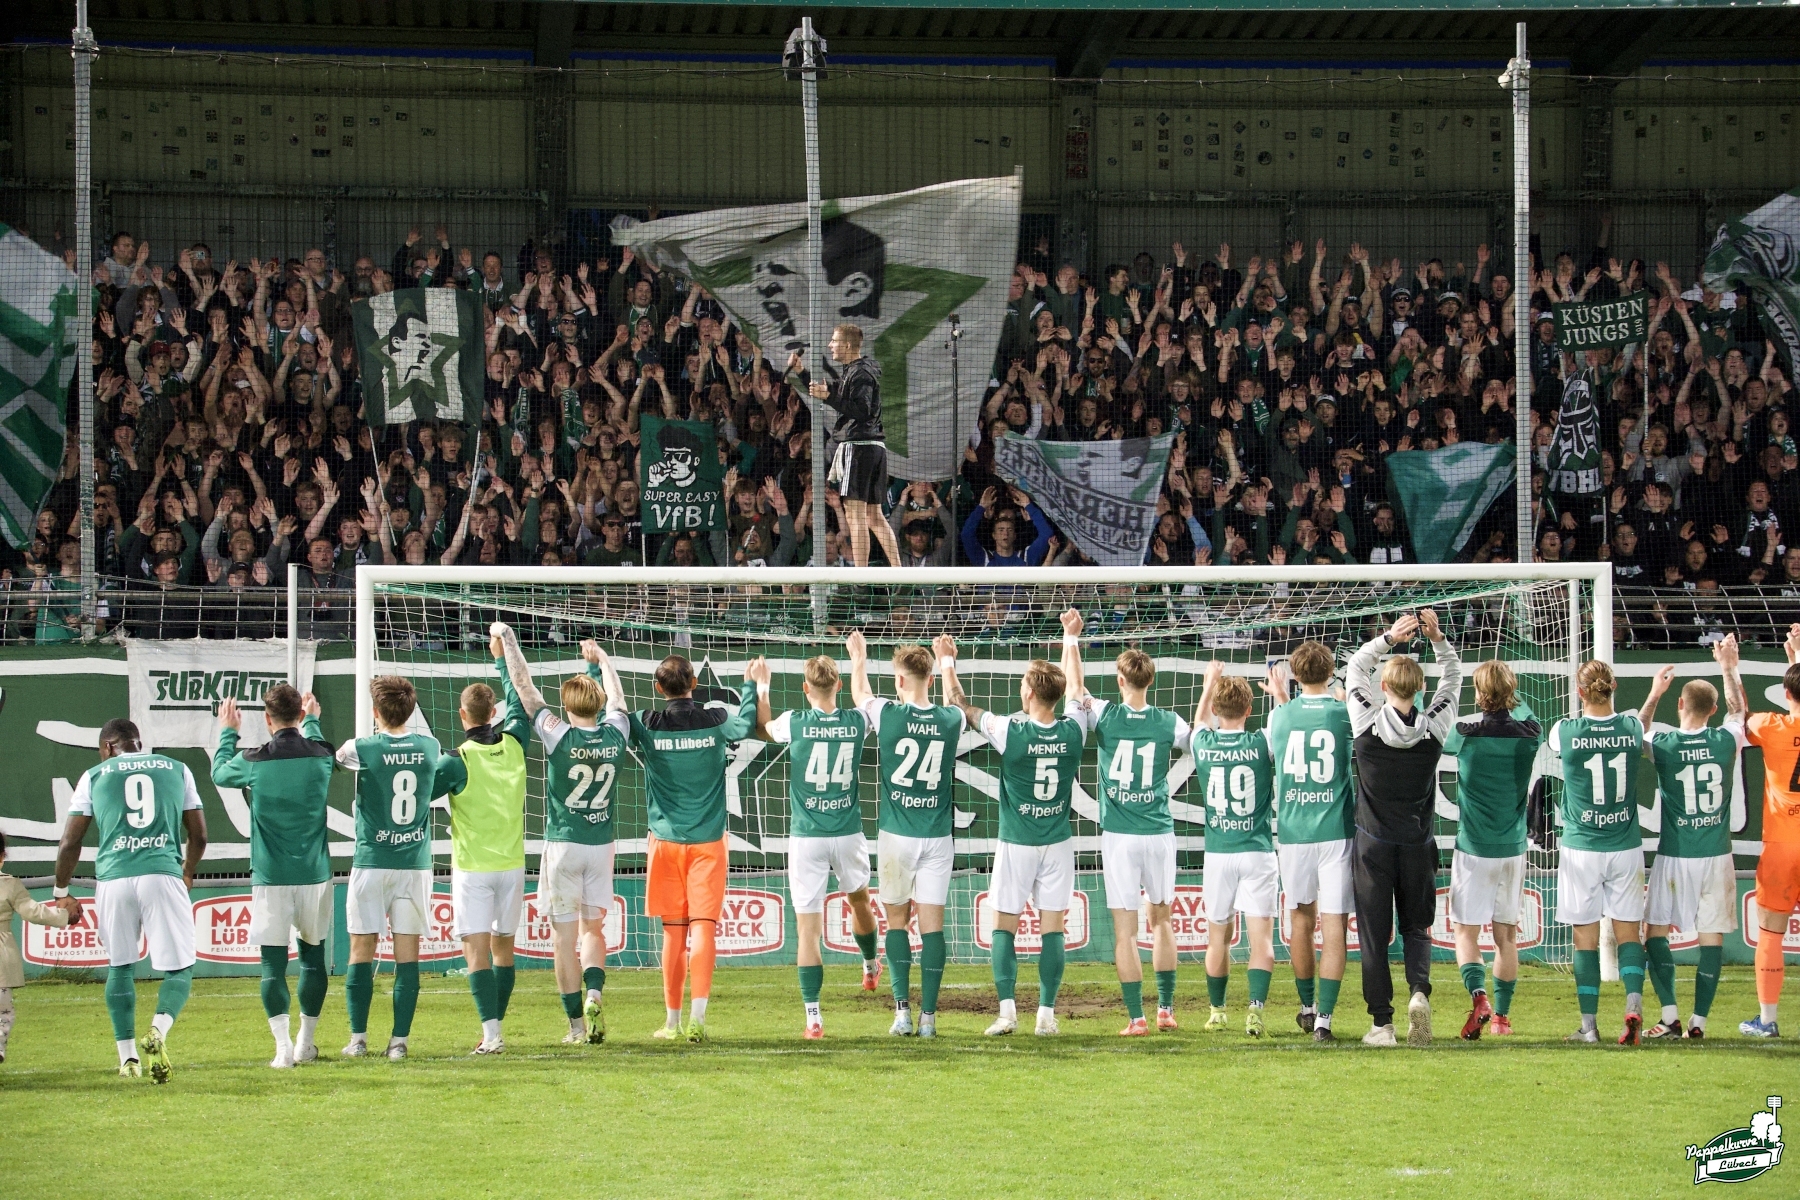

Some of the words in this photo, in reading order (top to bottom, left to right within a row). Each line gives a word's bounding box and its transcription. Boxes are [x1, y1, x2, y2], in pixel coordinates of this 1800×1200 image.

[1560, 298, 1644, 326] KÜSTEN
[1563, 322, 1629, 346] JUNGS
[1634, 318, 1645, 336] 1919
[644, 490, 682, 503] SUPER
[685, 490, 720, 503] EASY
[156, 671, 288, 701] SUBKULTU
[802, 726, 858, 738] LEHNFELD
[906, 722, 941, 736] WAHL
[654, 738, 673, 751] VfB
[675, 735, 716, 749] Lübeck
[1027, 743, 1067, 755] MENKE
[1571, 735, 1637, 750] DRINKUTH
[382, 752, 425, 766] WULFF
[569, 746, 618, 760] SOMMER
[1283, 729, 1336, 784] 43
[1679, 748, 1715, 762] THIEL
[100, 764, 115, 776] H.
[118, 759, 174, 771] BUKUSU
[804, 741, 855, 792] 44
[890, 737, 946, 790] 24
[1108, 739, 1156, 790] 41
[564, 762, 616, 810] 22
[1033, 757, 1060, 801] 5
[1583, 752, 1627, 805] 11
[391, 769, 418, 826] 8
[1118, 788, 1155, 805] iperdi
[1206, 764, 1256, 816] 49
[1298, 788, 1334, 806] iperdi
[1675, 763, 1723, 815] 13
[124, 773, 156, 829] 9
[901, 792, 939, 809] iperdi
[1219, 816, 1254, 833] iperdi
[1594, 806, 1630, 828] iperdi
[126, 833, 169, 853] iperdi
[390, 827, 425, 846] iperdi
[211, 905, 253, 927] MA
[211, 928, 249, 946] LÜB
[715, 921, 765, 937] BECK
[44, 931, 103, 949] LÜBE
